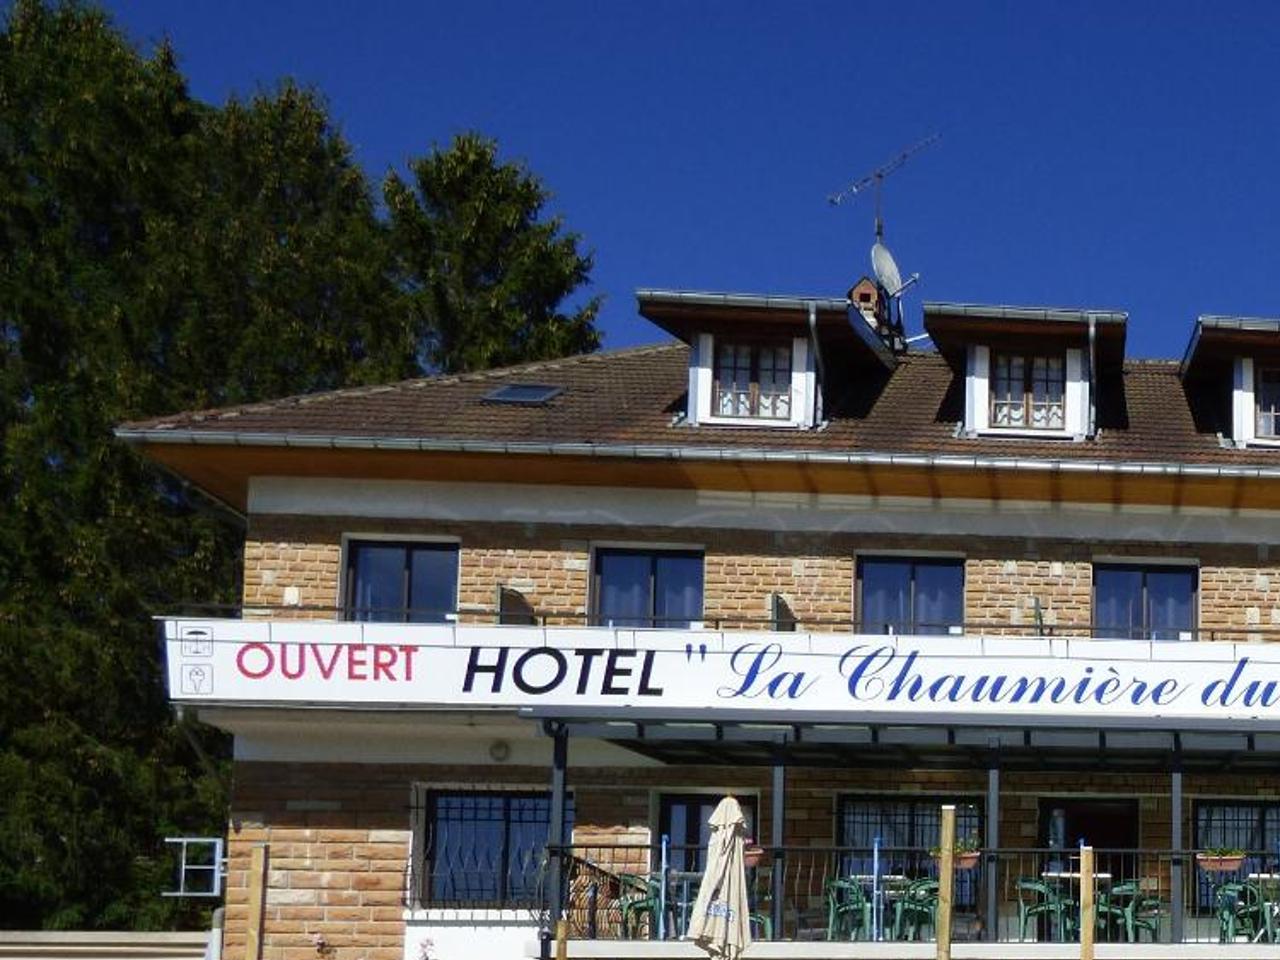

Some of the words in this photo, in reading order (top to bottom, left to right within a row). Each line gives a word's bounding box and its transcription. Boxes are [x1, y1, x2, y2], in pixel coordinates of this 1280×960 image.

[236, 641, 419, 682] OUVERT
[462, 646, 664, 696] HOTEL
[838, 645, 1194, 704] Chaumière
